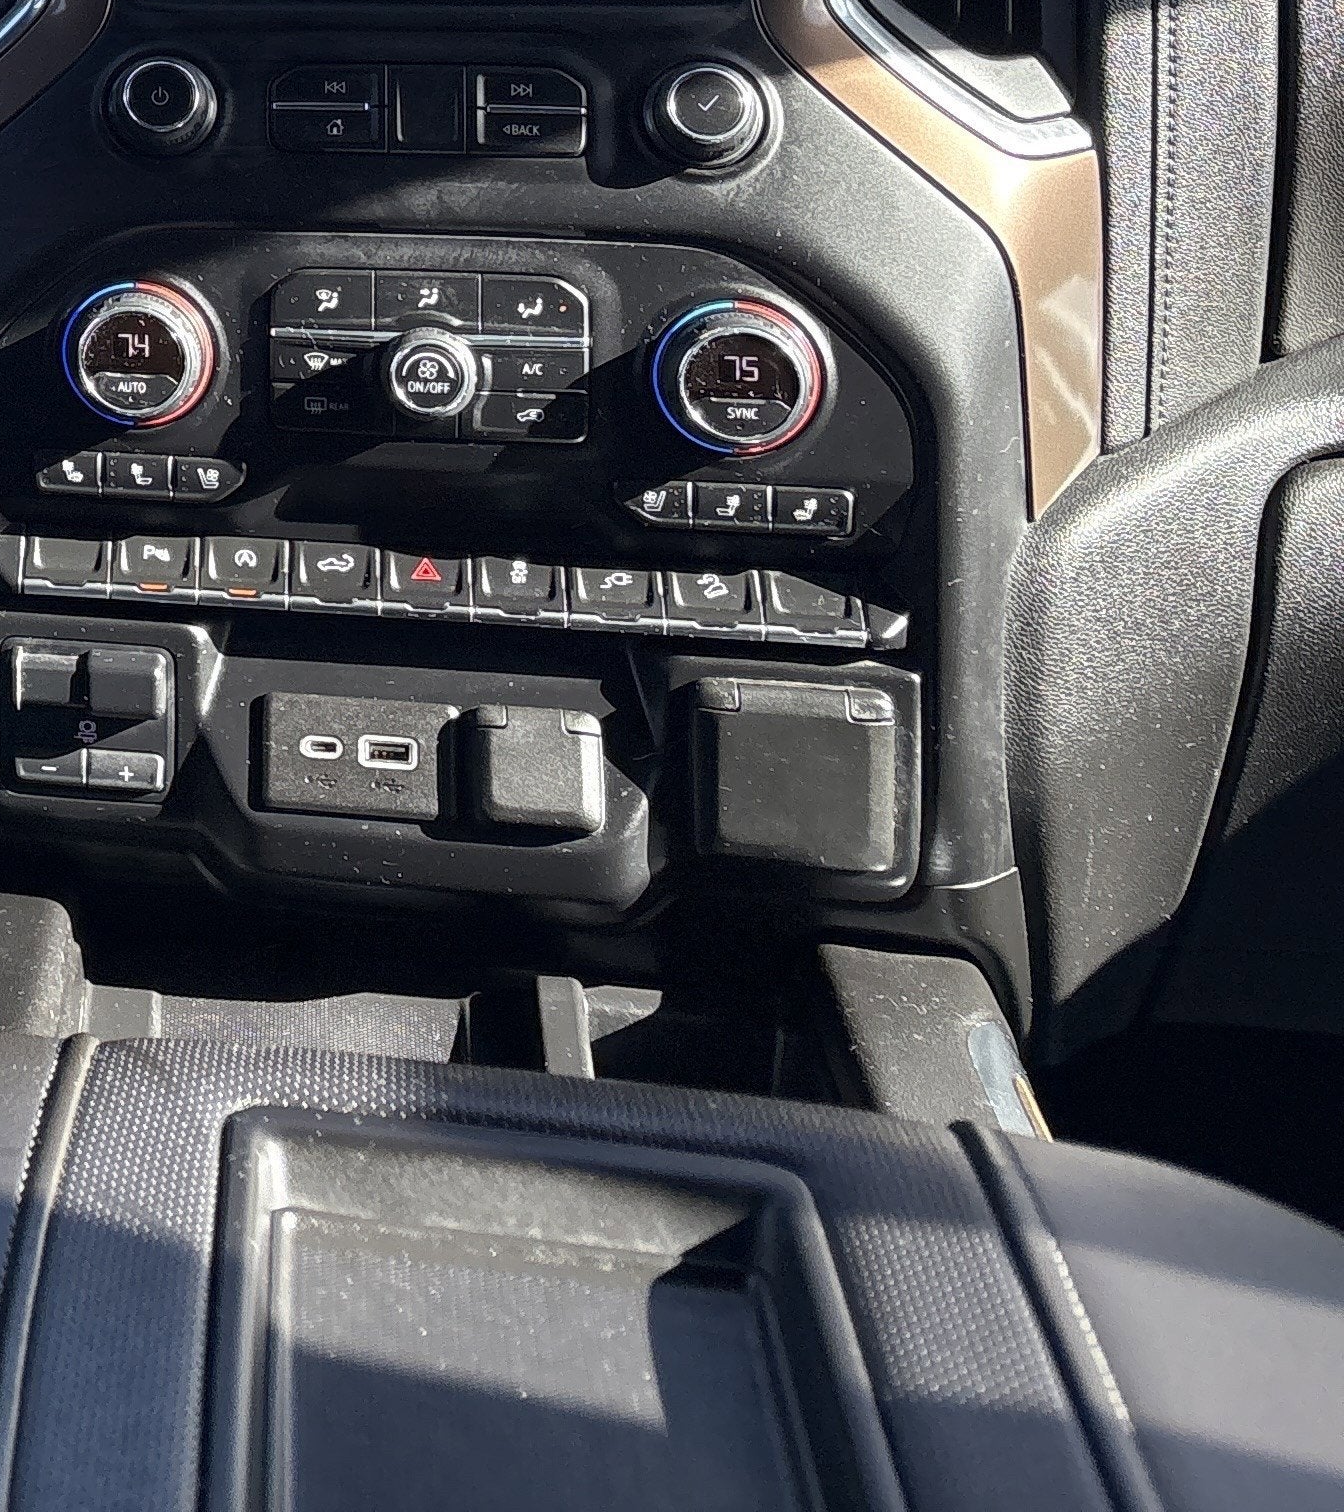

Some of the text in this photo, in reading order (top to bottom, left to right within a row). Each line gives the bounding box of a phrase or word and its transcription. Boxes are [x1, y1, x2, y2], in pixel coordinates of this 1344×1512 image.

[511, 124, 541, 137] BACK
[117, 333, 150, 360] 74
[330, 357, 348, 366] MAX
[522, 363, 544, 377] A/C
[725, 355, 759, 384] 75
[118, 381, 147, 395] AUTO
[408, 381, 450, 396] ON/OFF
[726, 407, 759, 421] SYNC
